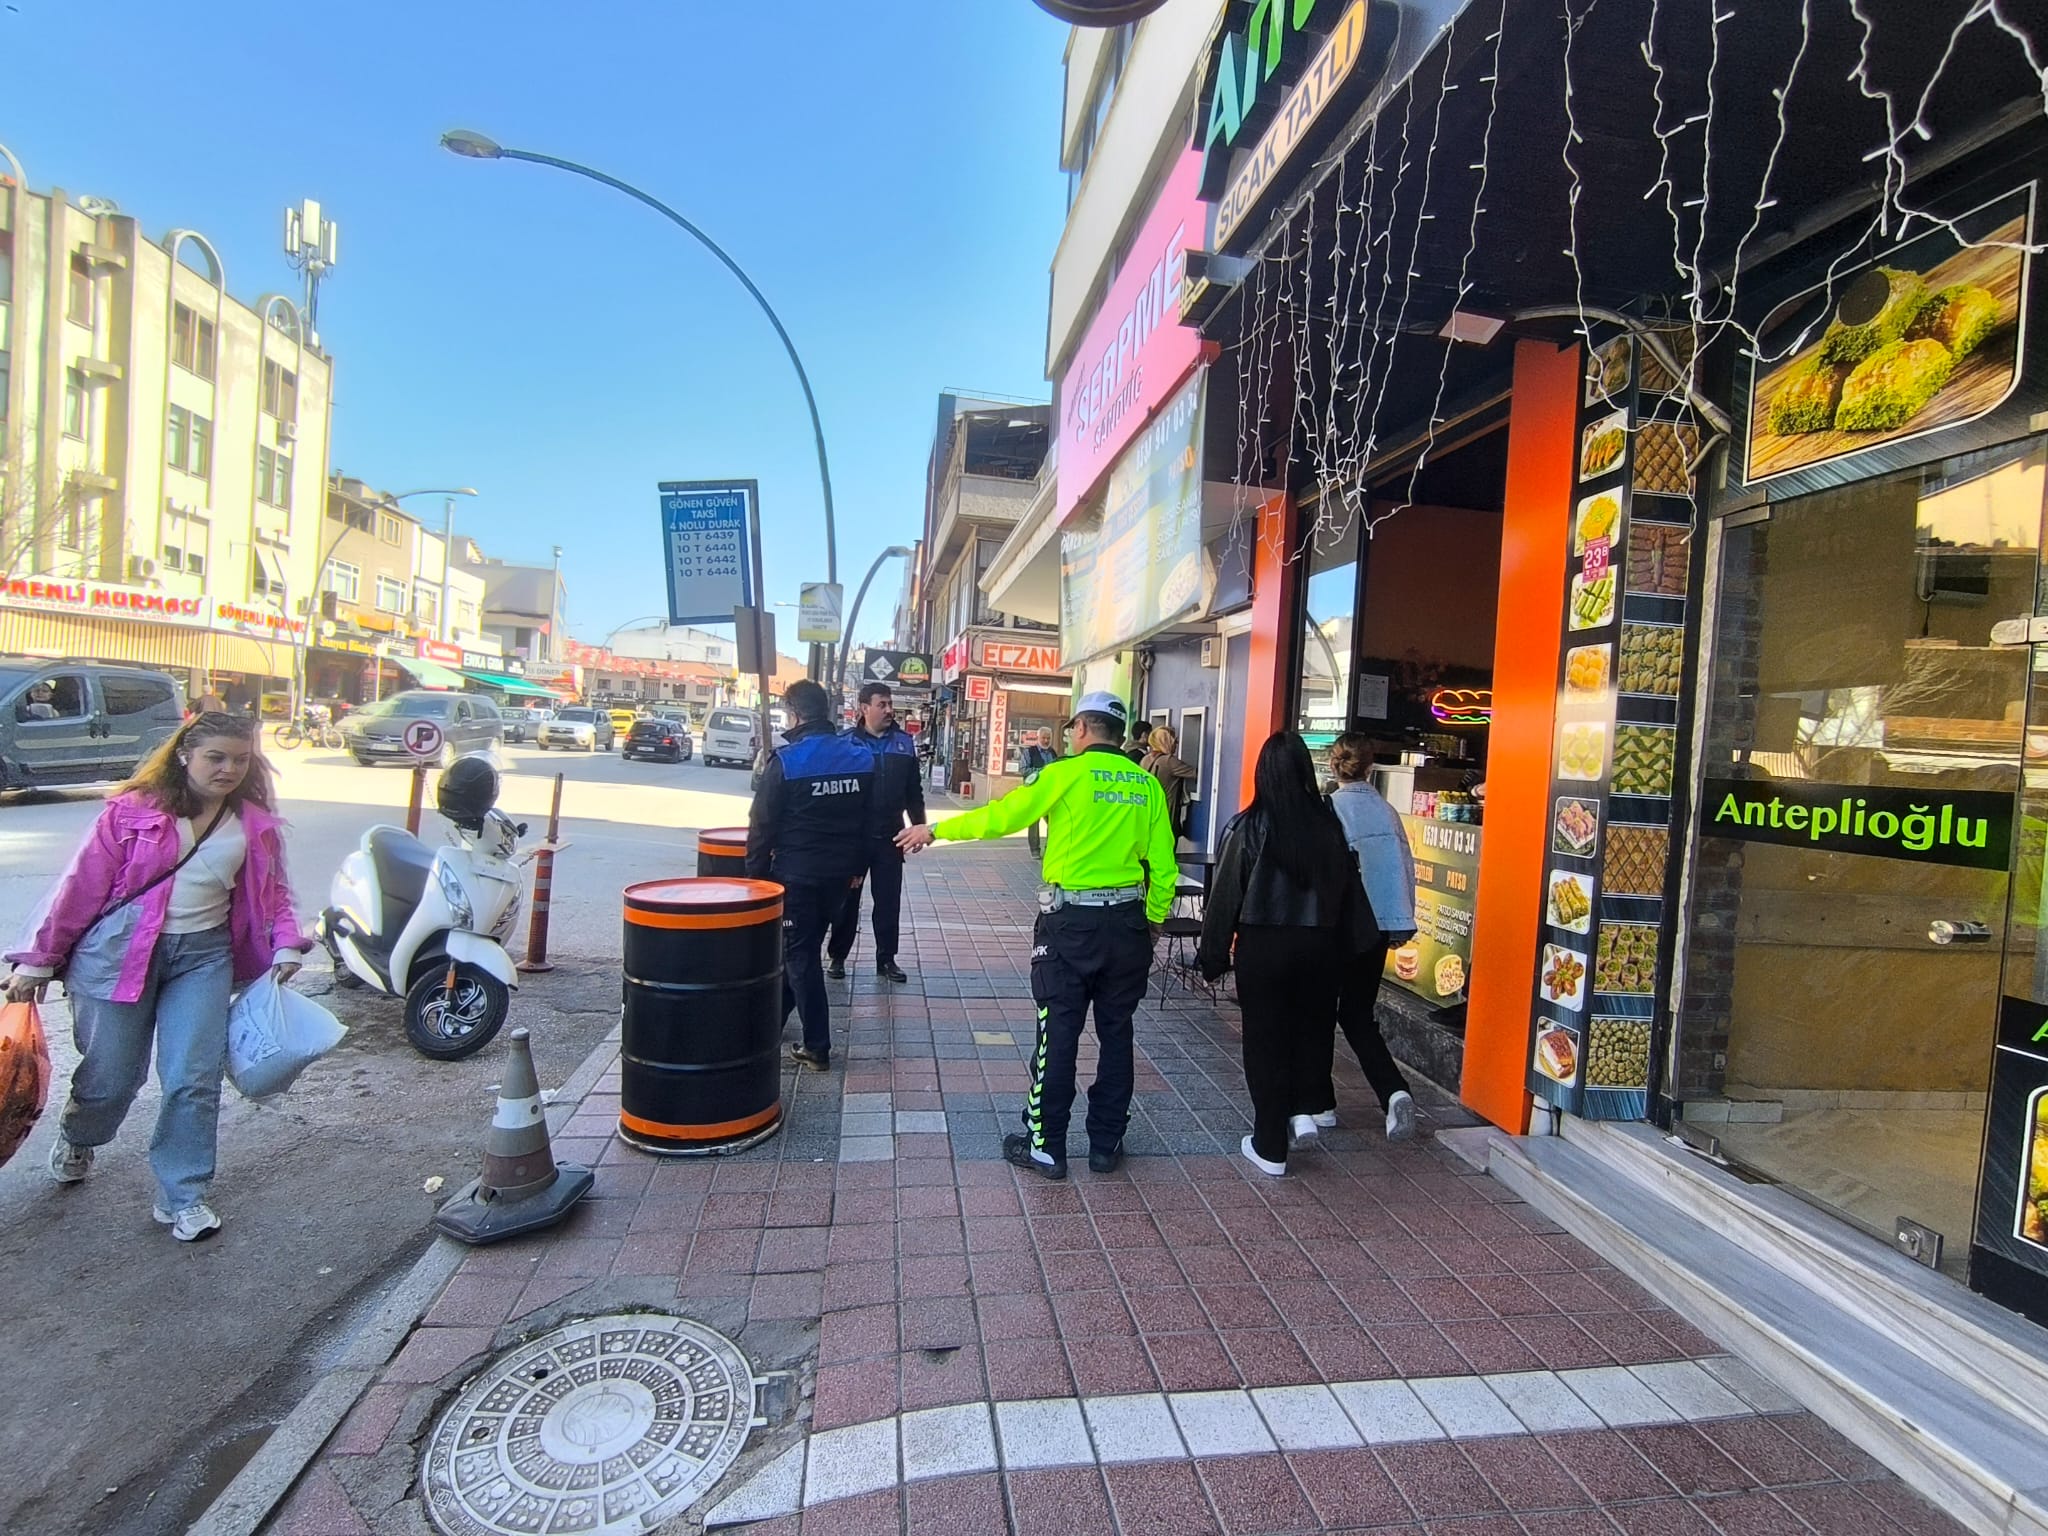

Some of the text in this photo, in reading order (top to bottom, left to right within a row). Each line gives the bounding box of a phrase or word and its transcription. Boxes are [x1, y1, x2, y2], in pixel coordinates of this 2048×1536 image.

[1218, 16, 1355, 240] SICAK TATLI
[1076, 221, 1185, 443] SERPME
[669, 496, 738, 509] GÖNEN GÜVEN
[691, 509, 717, 519] TAKSİ
[669, 519, 741, 531] 4 NOLU DURAK
[677, 531, 735, 542] 10 T 6439
[677, 543, 736, 553] 10 T 6440
[678, 555, 737, 565] 10 T 6442
[679, 567, 738, 577] 10 T 6446
[983, 643, 1060, 670] ECZAN
[970, 680, 987, 698] E
[991, 695, 1005, 771] ECZANE
[811, 777, 860, 797] ZABITA
[1093, 790, 1149, 807] POLİSİ
[1714, 792, 1989, 850] Anteplioğlu
[1440, 828, 1453, 850] 947
[1454, 830, 1464, 852] 03
[1465, 833, 1475, 855] 34
[1446, 870, 1467, 892] PATSO
